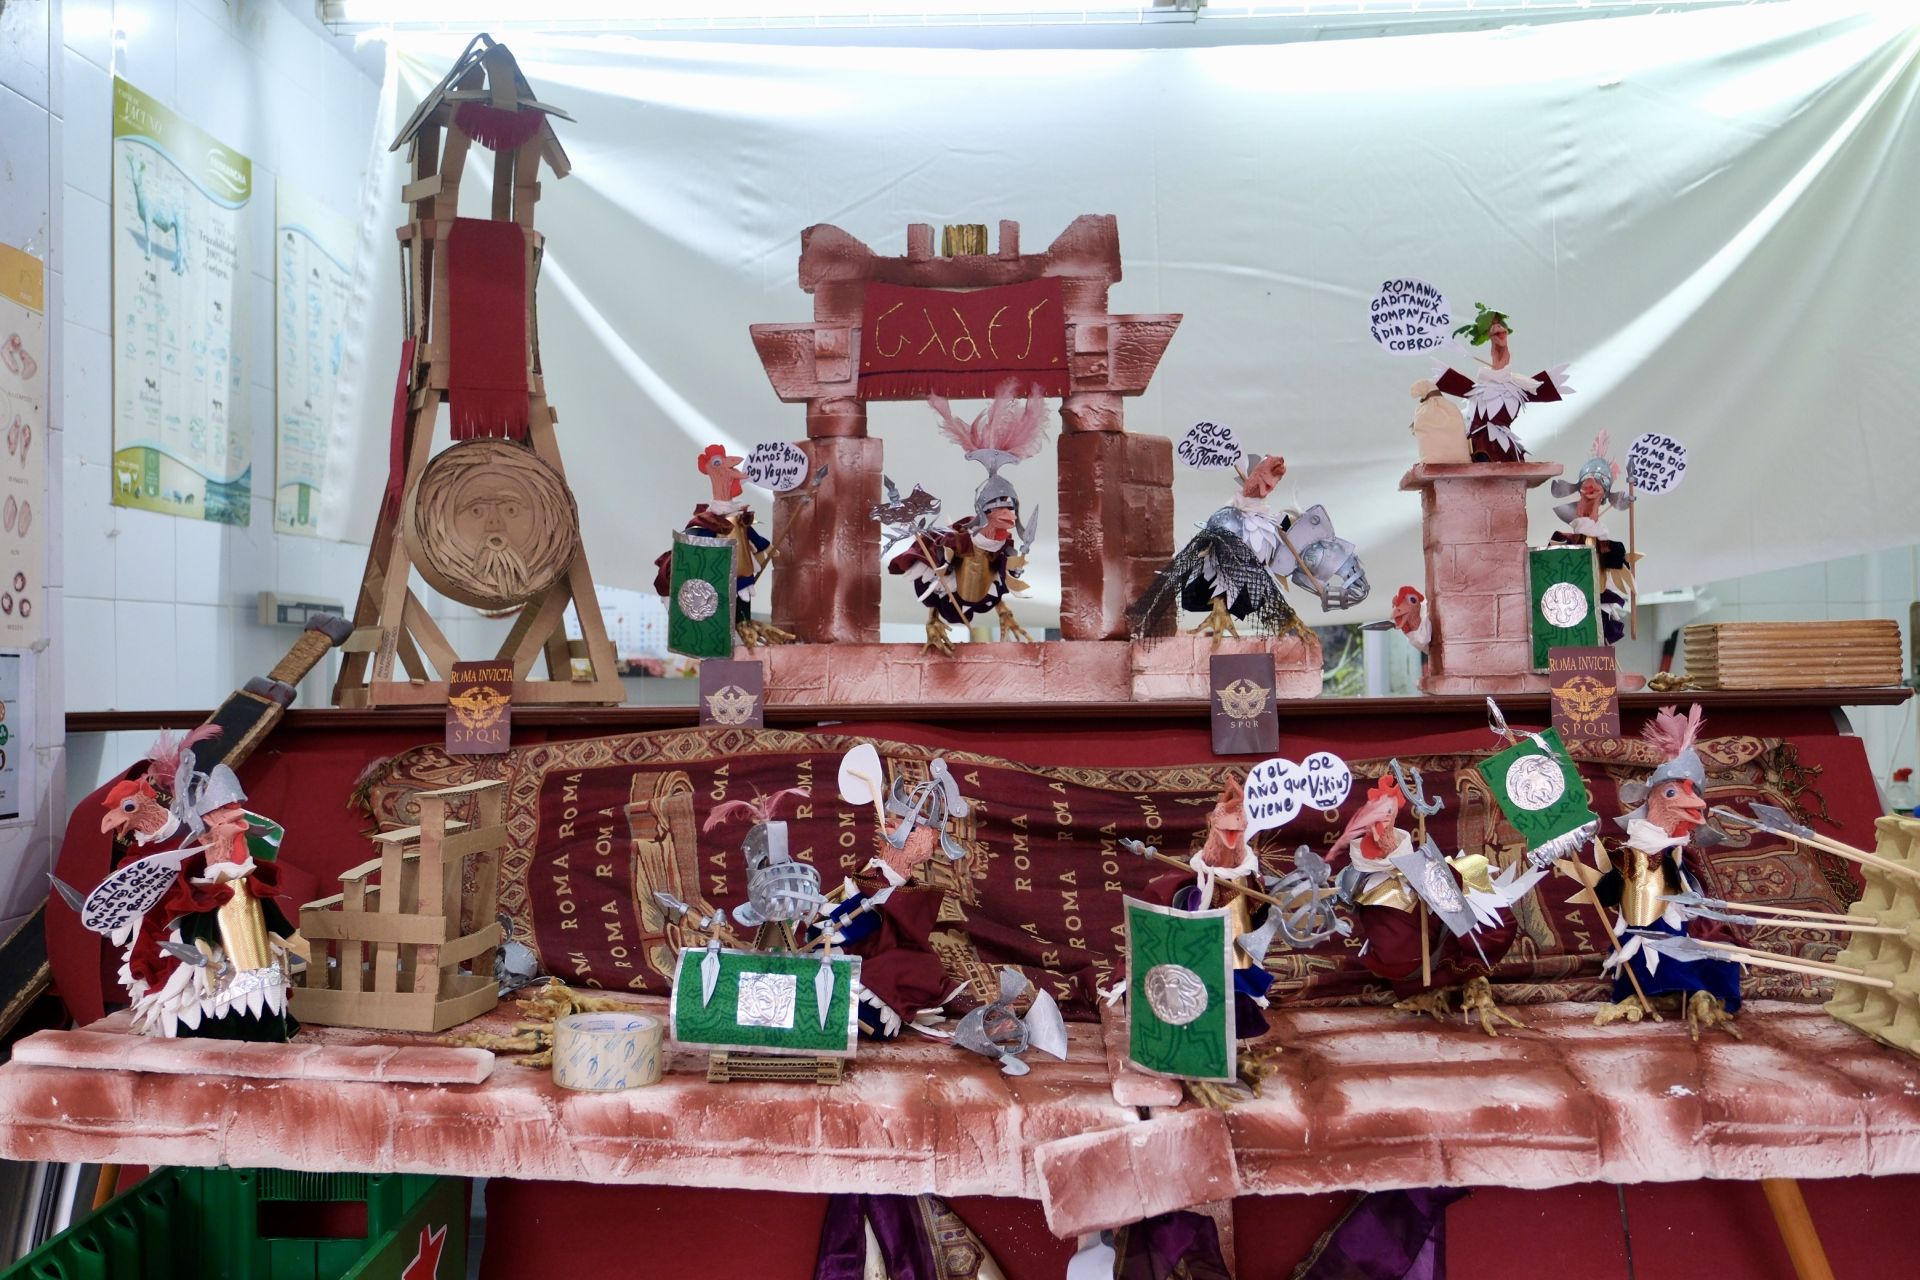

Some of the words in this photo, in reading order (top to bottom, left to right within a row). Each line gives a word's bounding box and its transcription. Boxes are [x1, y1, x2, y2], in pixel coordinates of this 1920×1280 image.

[1382, 280, 1443, 304] ROMANUX
[451, 669, 477, 683] ROMA
[479, 668, 513, 681] INVICTA
[1549, 657, 1577, 672] ROMA
[1578, 656, 1616, 671] INVICTA
[559, 772, 583, 840] ROMA
[1049, 781, 1074, 842] ROMA
[594, 806, 616, 878] ROMA
[1011, 813, 1033, 893] ROMA
[1101, 821, 1123, 892] ROMA
[552, 853, 579, 931] ROMA
[1059, 869, 1087, 951] ROMA
[600, 899, 633, 969] ROMA
